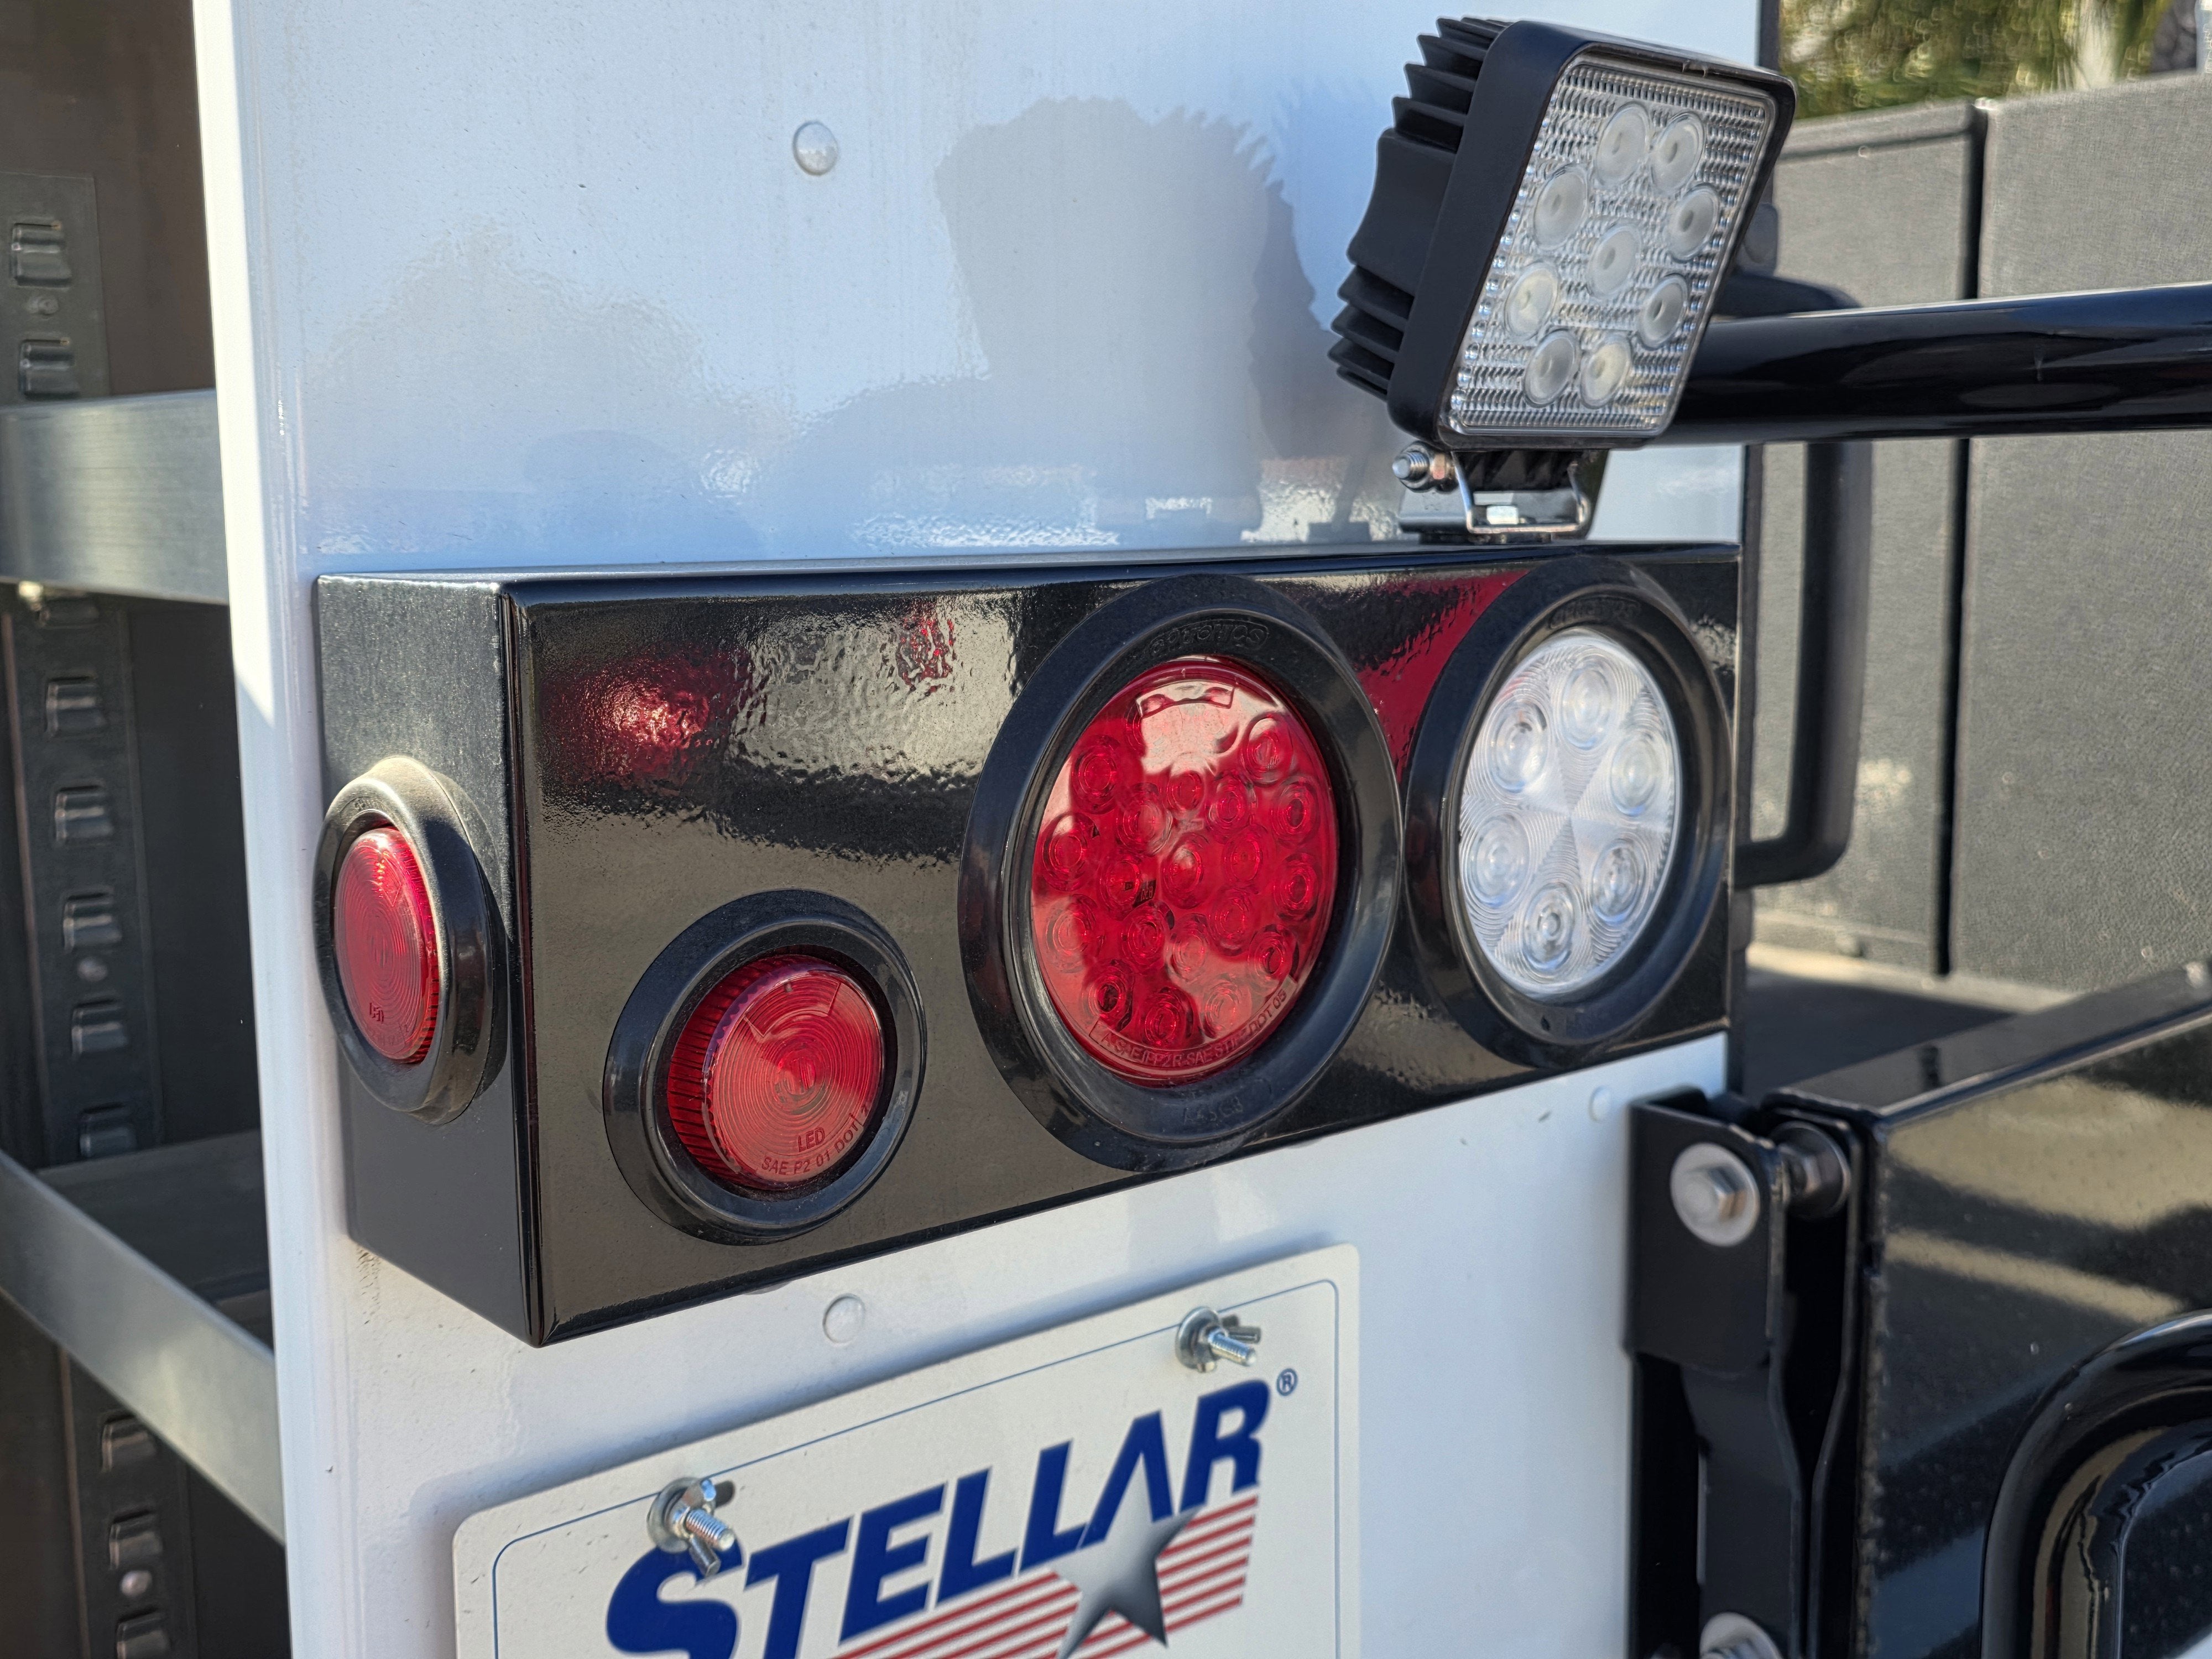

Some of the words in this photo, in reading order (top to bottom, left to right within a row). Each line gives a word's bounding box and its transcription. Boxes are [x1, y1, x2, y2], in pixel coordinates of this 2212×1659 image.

[761, 1155, 789, 1176] SAE
[794, 1158, 811, 1175] P2
[834, 1120, 859, 1154] DOT
[797, 1126, 826, 1152] LED
